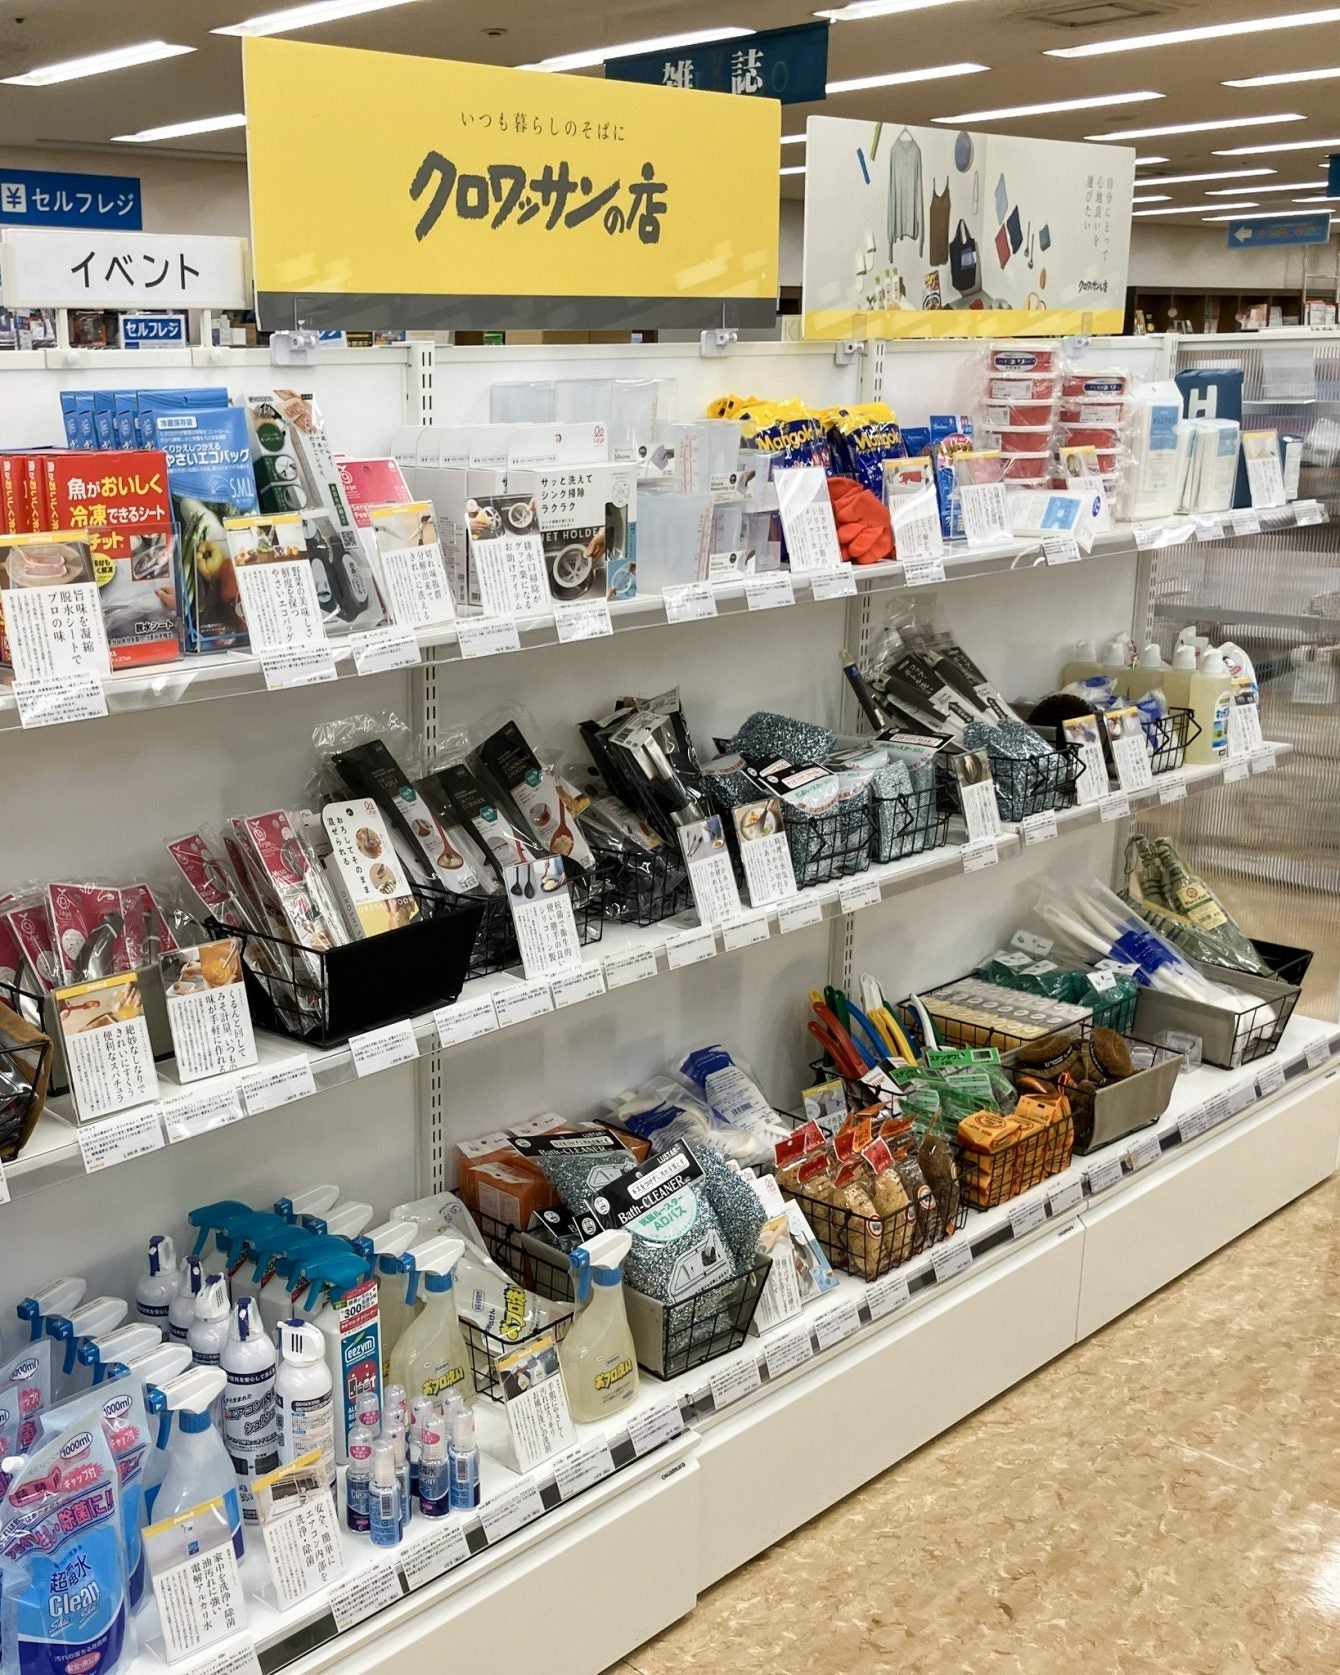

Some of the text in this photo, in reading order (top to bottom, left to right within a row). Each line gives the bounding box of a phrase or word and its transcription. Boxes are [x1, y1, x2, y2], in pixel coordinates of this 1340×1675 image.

[662, 48, 764, 94] 雑誌
[460, 111, 626, 141] いつも暮らしのそばに
[31, 188, 134, 216] セルフレジ
[409, 150, 668, 245] クロワッサンの店
[1103, 177, 1114, 261] 自分にとって
[70, 251, 200, 290] イベント
[125, 320, 180, 338] セルフレジ
[67, 473, 163, 501] 魚がおいしく
[540, 473, 594, 487] サッと洗えて
[540, 488, 585, 501] シンク掃除
[69, 503, 166, 528] 冷凍できるシート
[540, 501, 576, 514] ラクラク
[817, 506, 832, 547] 注ぎやすい
[805, 507, 820, 565] メジャーカップ
[281, 567, 300, 618] 鮮度を保つ
[409, 552, 430, 621] きれいに洗える
[416, 551, 434, 601] 分解出来て
[424, 550, 442, 600] 切れ味抜群
[504, 542, 523, 611] お助けアイテム
[514, 541, 531, 610] グッと楽になる
[523, 541, 540, 604] 排水口掃除が
[48, 592, 66, 642] プロの味
[60, 591, 82, 665] 脱水シートで
[73, 590, 95, 654] 旨味を凝縮
[135, 621, 174, 635] 脱水シート
[271, 568, 294, 643] やさいエコバッグ
[291, 566, 313, 639] 野菜の美味しさ
[326, 817, 351, 867] 混ぜられる
[336, 816, 371, 894] おろしてそのまま
[539, 905, 557, 963] シリコーン製
[546, 902, 566, 967] 使い勝手の良い
[554, 901, 573, 957] 抗菌で衛生的
[205, 993, 226, 1073] 味が手軽に作れる
[228, 990, 246, 1058] くるんと回して
[103, 1031, 124, 1104] 便利なスパチュラ
[115, 1027, 135, 1098] きれいにすくう
[125, 1024, 145, 1094] 絶妙なしなりで
[617, 1173, 685, 1225] Bath-CLEANER
[344, 1303, 362, 1319] 300
[346, 1339, 374, 1360] eezym
[594, 1358, 634, 1391] おフロ洗い
[102, 1398, 131, 1417] 1000ml
[421, 1366, 465, 1397] おフロ洗い
[61, 1436, 92, 1457] 1000ml
[63, 1467, 98, 1489] キャップ付
[295, 1513, 316, 1569] 洗浄・除菌
[305, 1509, 329, 1583] エアコン内部を
[314, 1502, 336, 1565] 安全、簡単に
[48, 1580, 101, 1618] Clean
[190, 1562, 213, 1632] 電解アルカリ水
[201, 1557, 222, 1616] 油汚れに強い
[212, 1552, 237, 1630] 家中を洗浄・除菌
